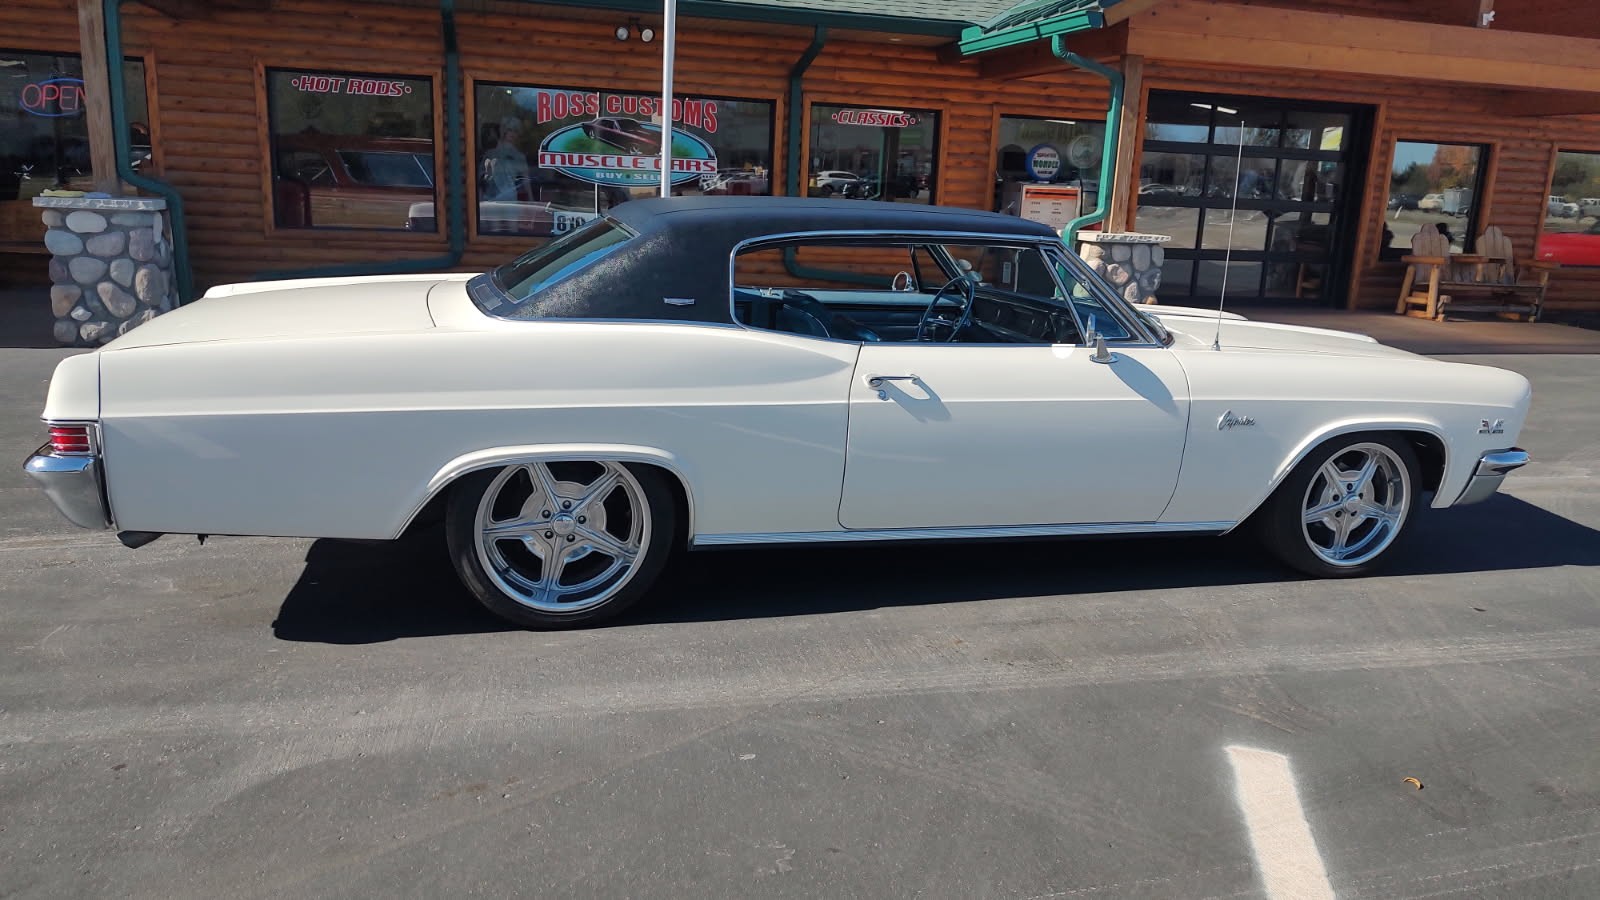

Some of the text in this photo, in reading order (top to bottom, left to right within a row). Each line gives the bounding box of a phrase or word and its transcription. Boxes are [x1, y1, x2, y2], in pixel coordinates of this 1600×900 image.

[299, 75, 404, 96] HOT RODS
[22, 83, 88, 110] OPEN
[537, 91, 600, 124] ROSS
[837, 110, 911, 128] CLASSICS
[539, 151, 648, 169] MUSCLE
